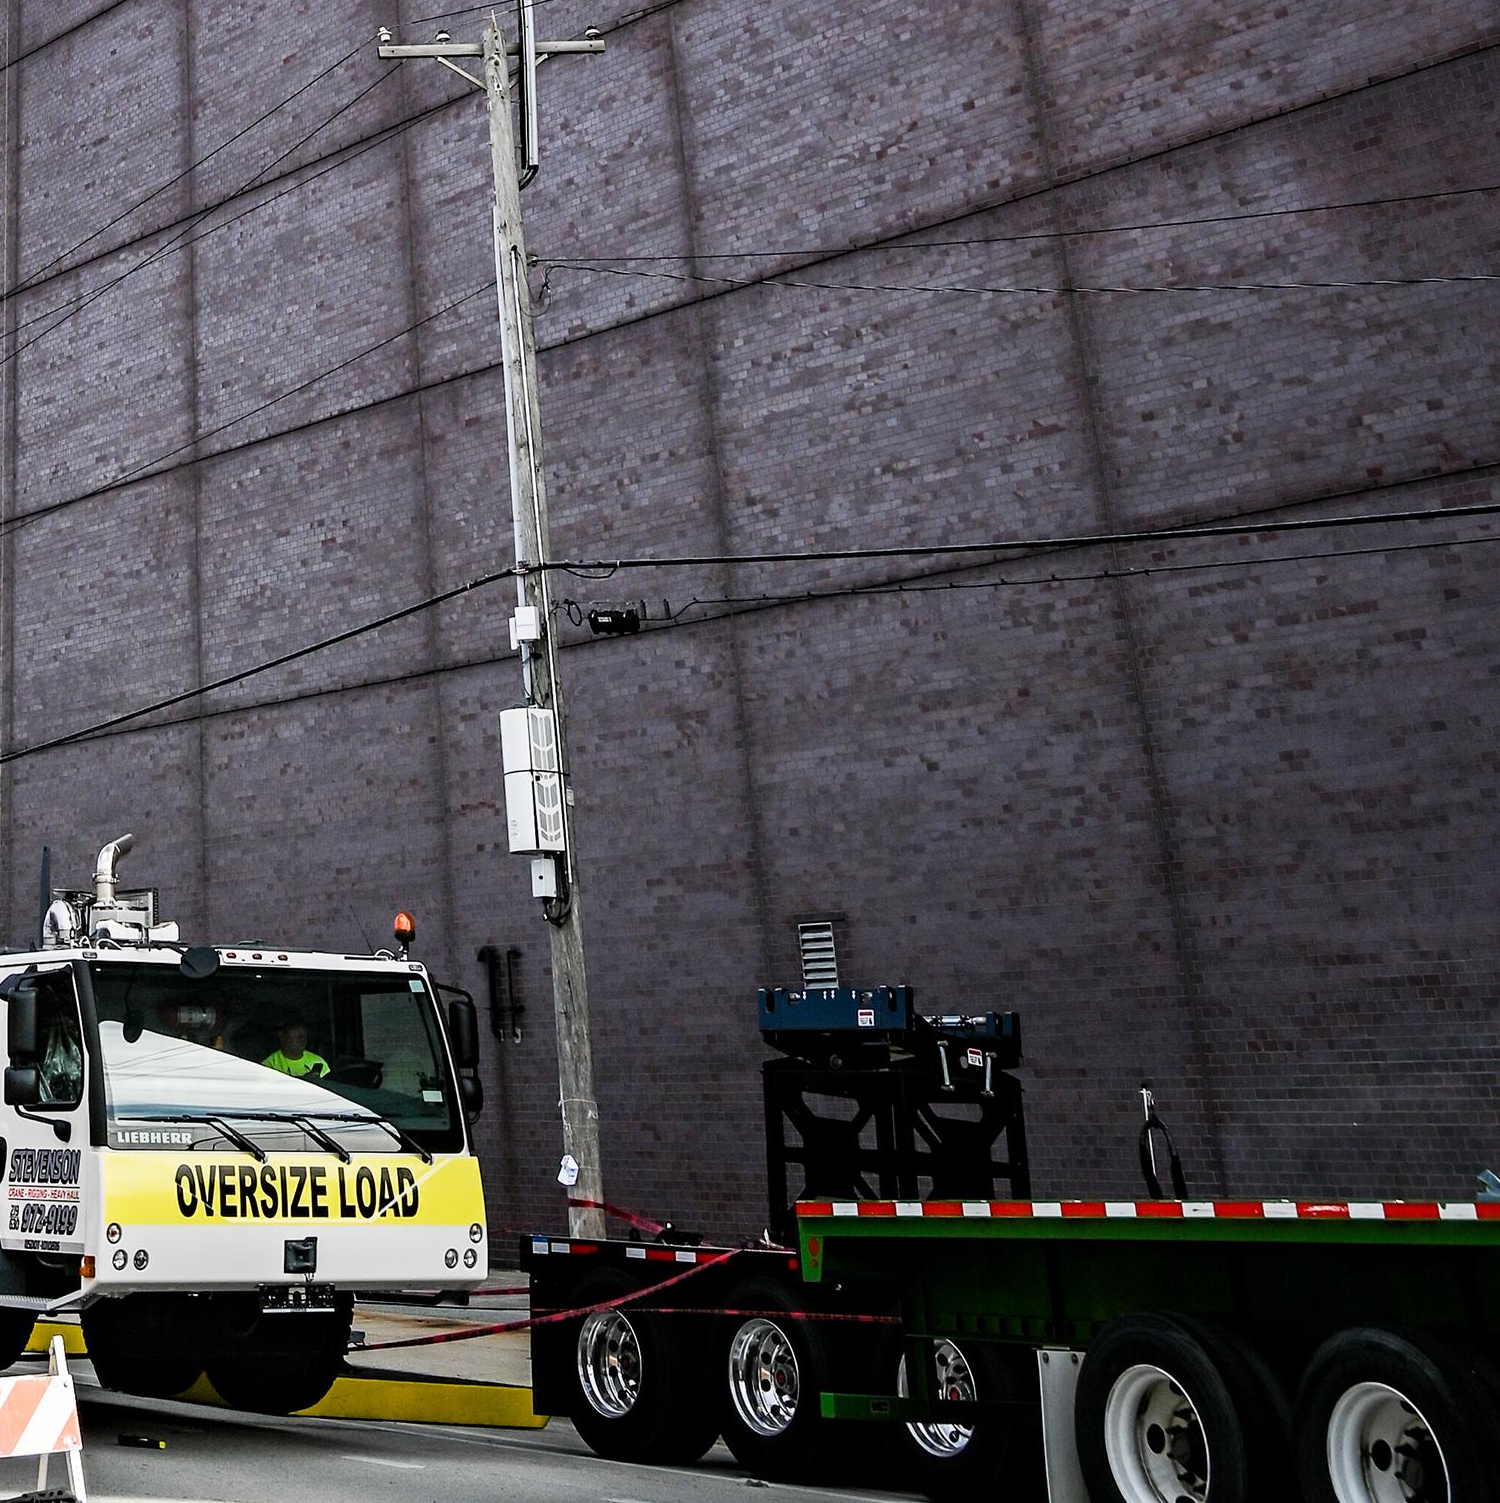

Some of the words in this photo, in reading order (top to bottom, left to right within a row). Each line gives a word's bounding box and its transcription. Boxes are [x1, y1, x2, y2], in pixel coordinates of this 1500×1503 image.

[117, 1131, 193, 1144] LIEBHERR
[8, 1148, 81, 1185] STEVENSON
[175, 1164, 329, 1219] OVERSIZE
[338, 1165, 419, 1219] LOAD
[20, 1202, 79, 1235] 972-9199
